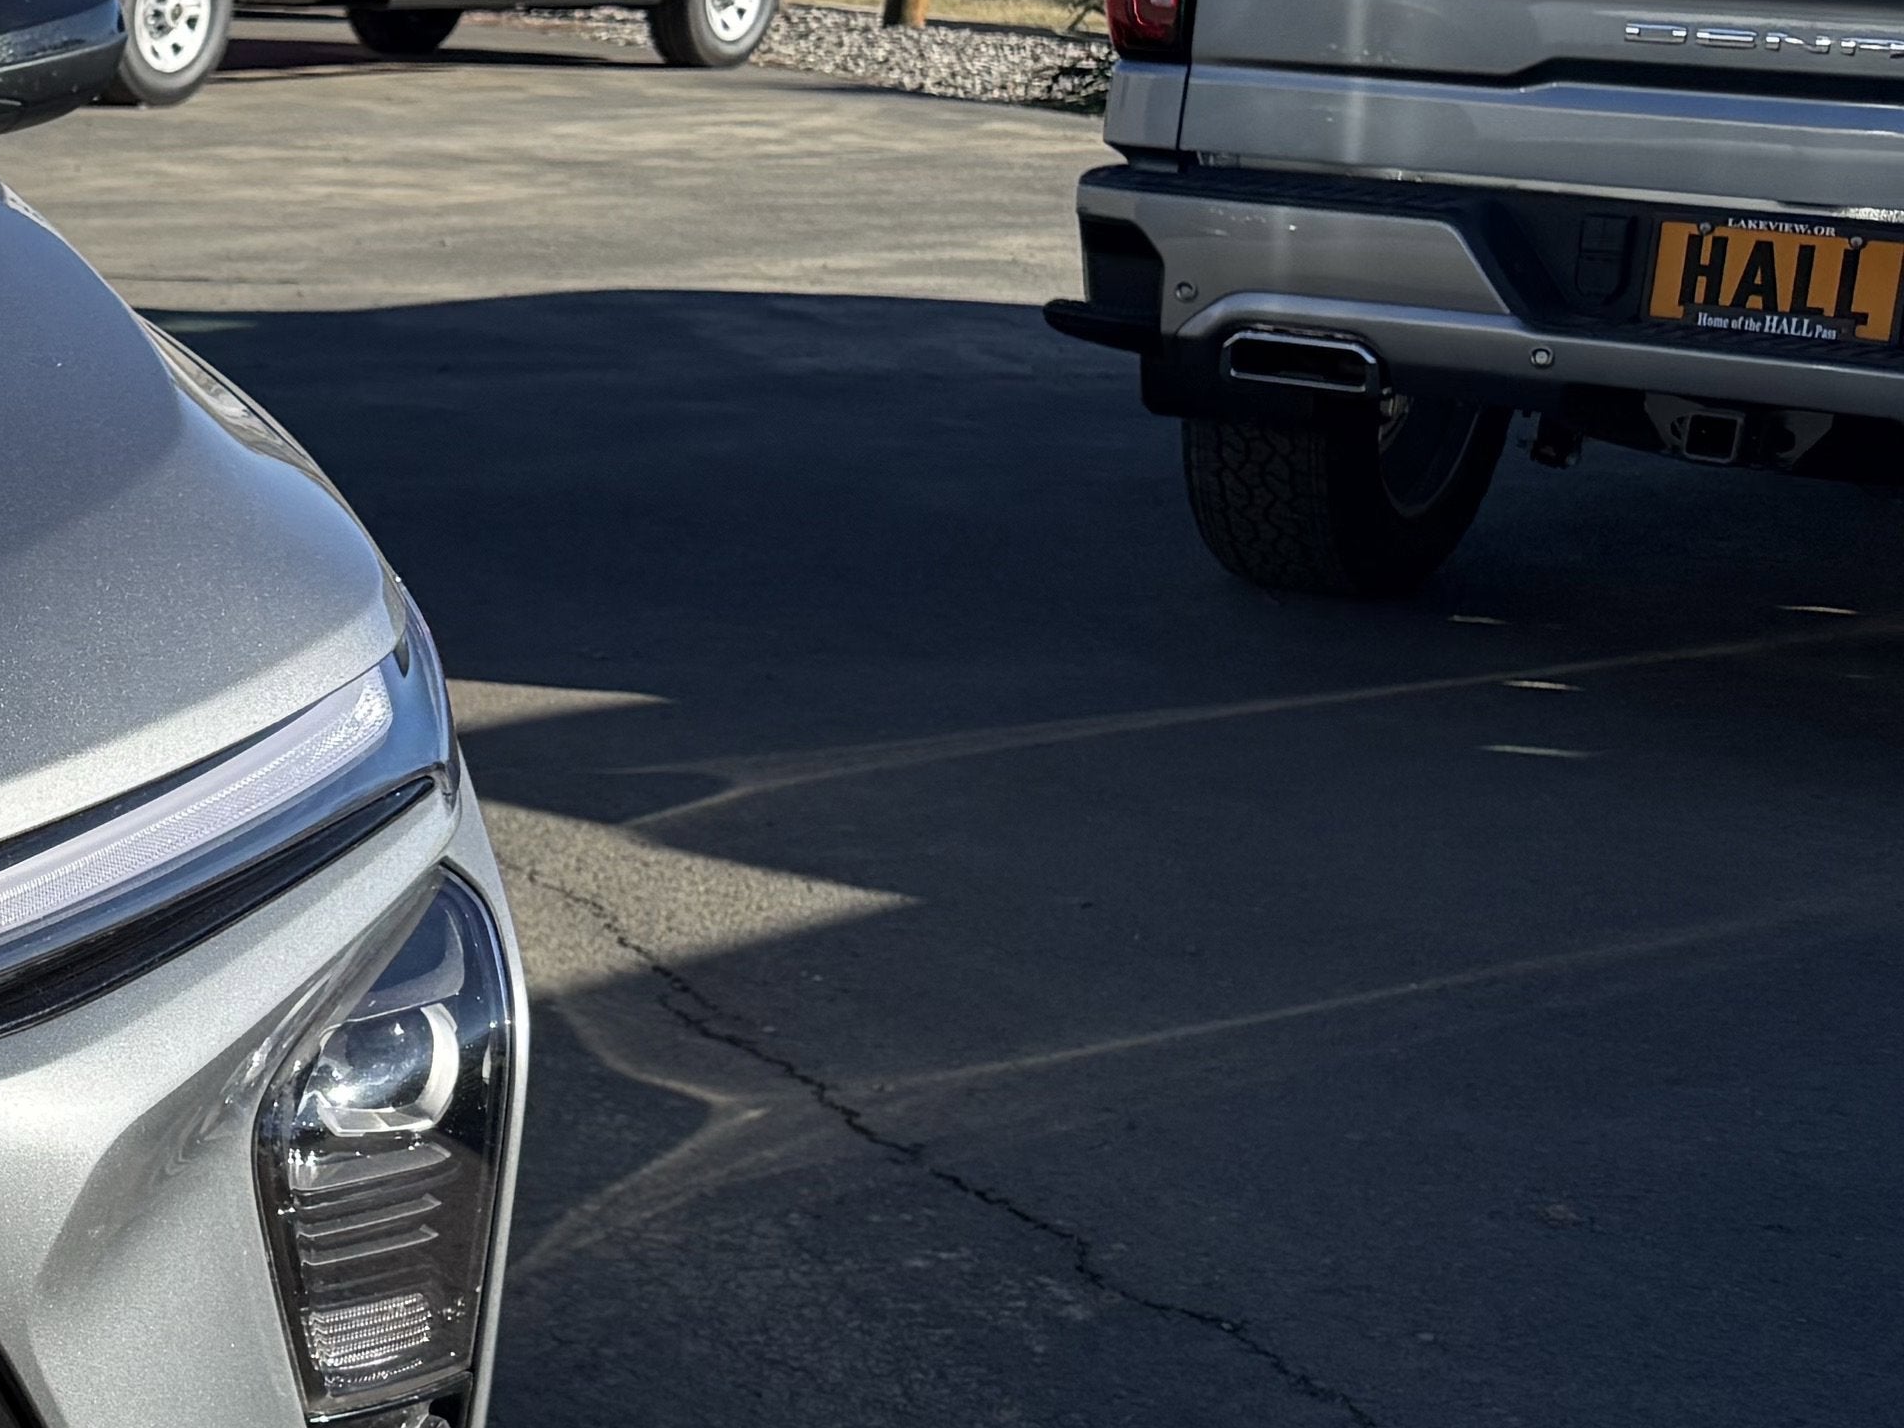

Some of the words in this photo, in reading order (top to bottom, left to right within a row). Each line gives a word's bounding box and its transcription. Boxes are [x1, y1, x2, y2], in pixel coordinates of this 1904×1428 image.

[1814, 225, 1836, 237] OR
[1678, 233, 1869, 326] HALL
[1697, 312, 1729, 328] Home
[1731, 316, 1744, 329] of
[1744, 317, 1762, 332] the
[1764, 315, 1813, 338] HALL
[1814, 326, 1837, 340] Pass
